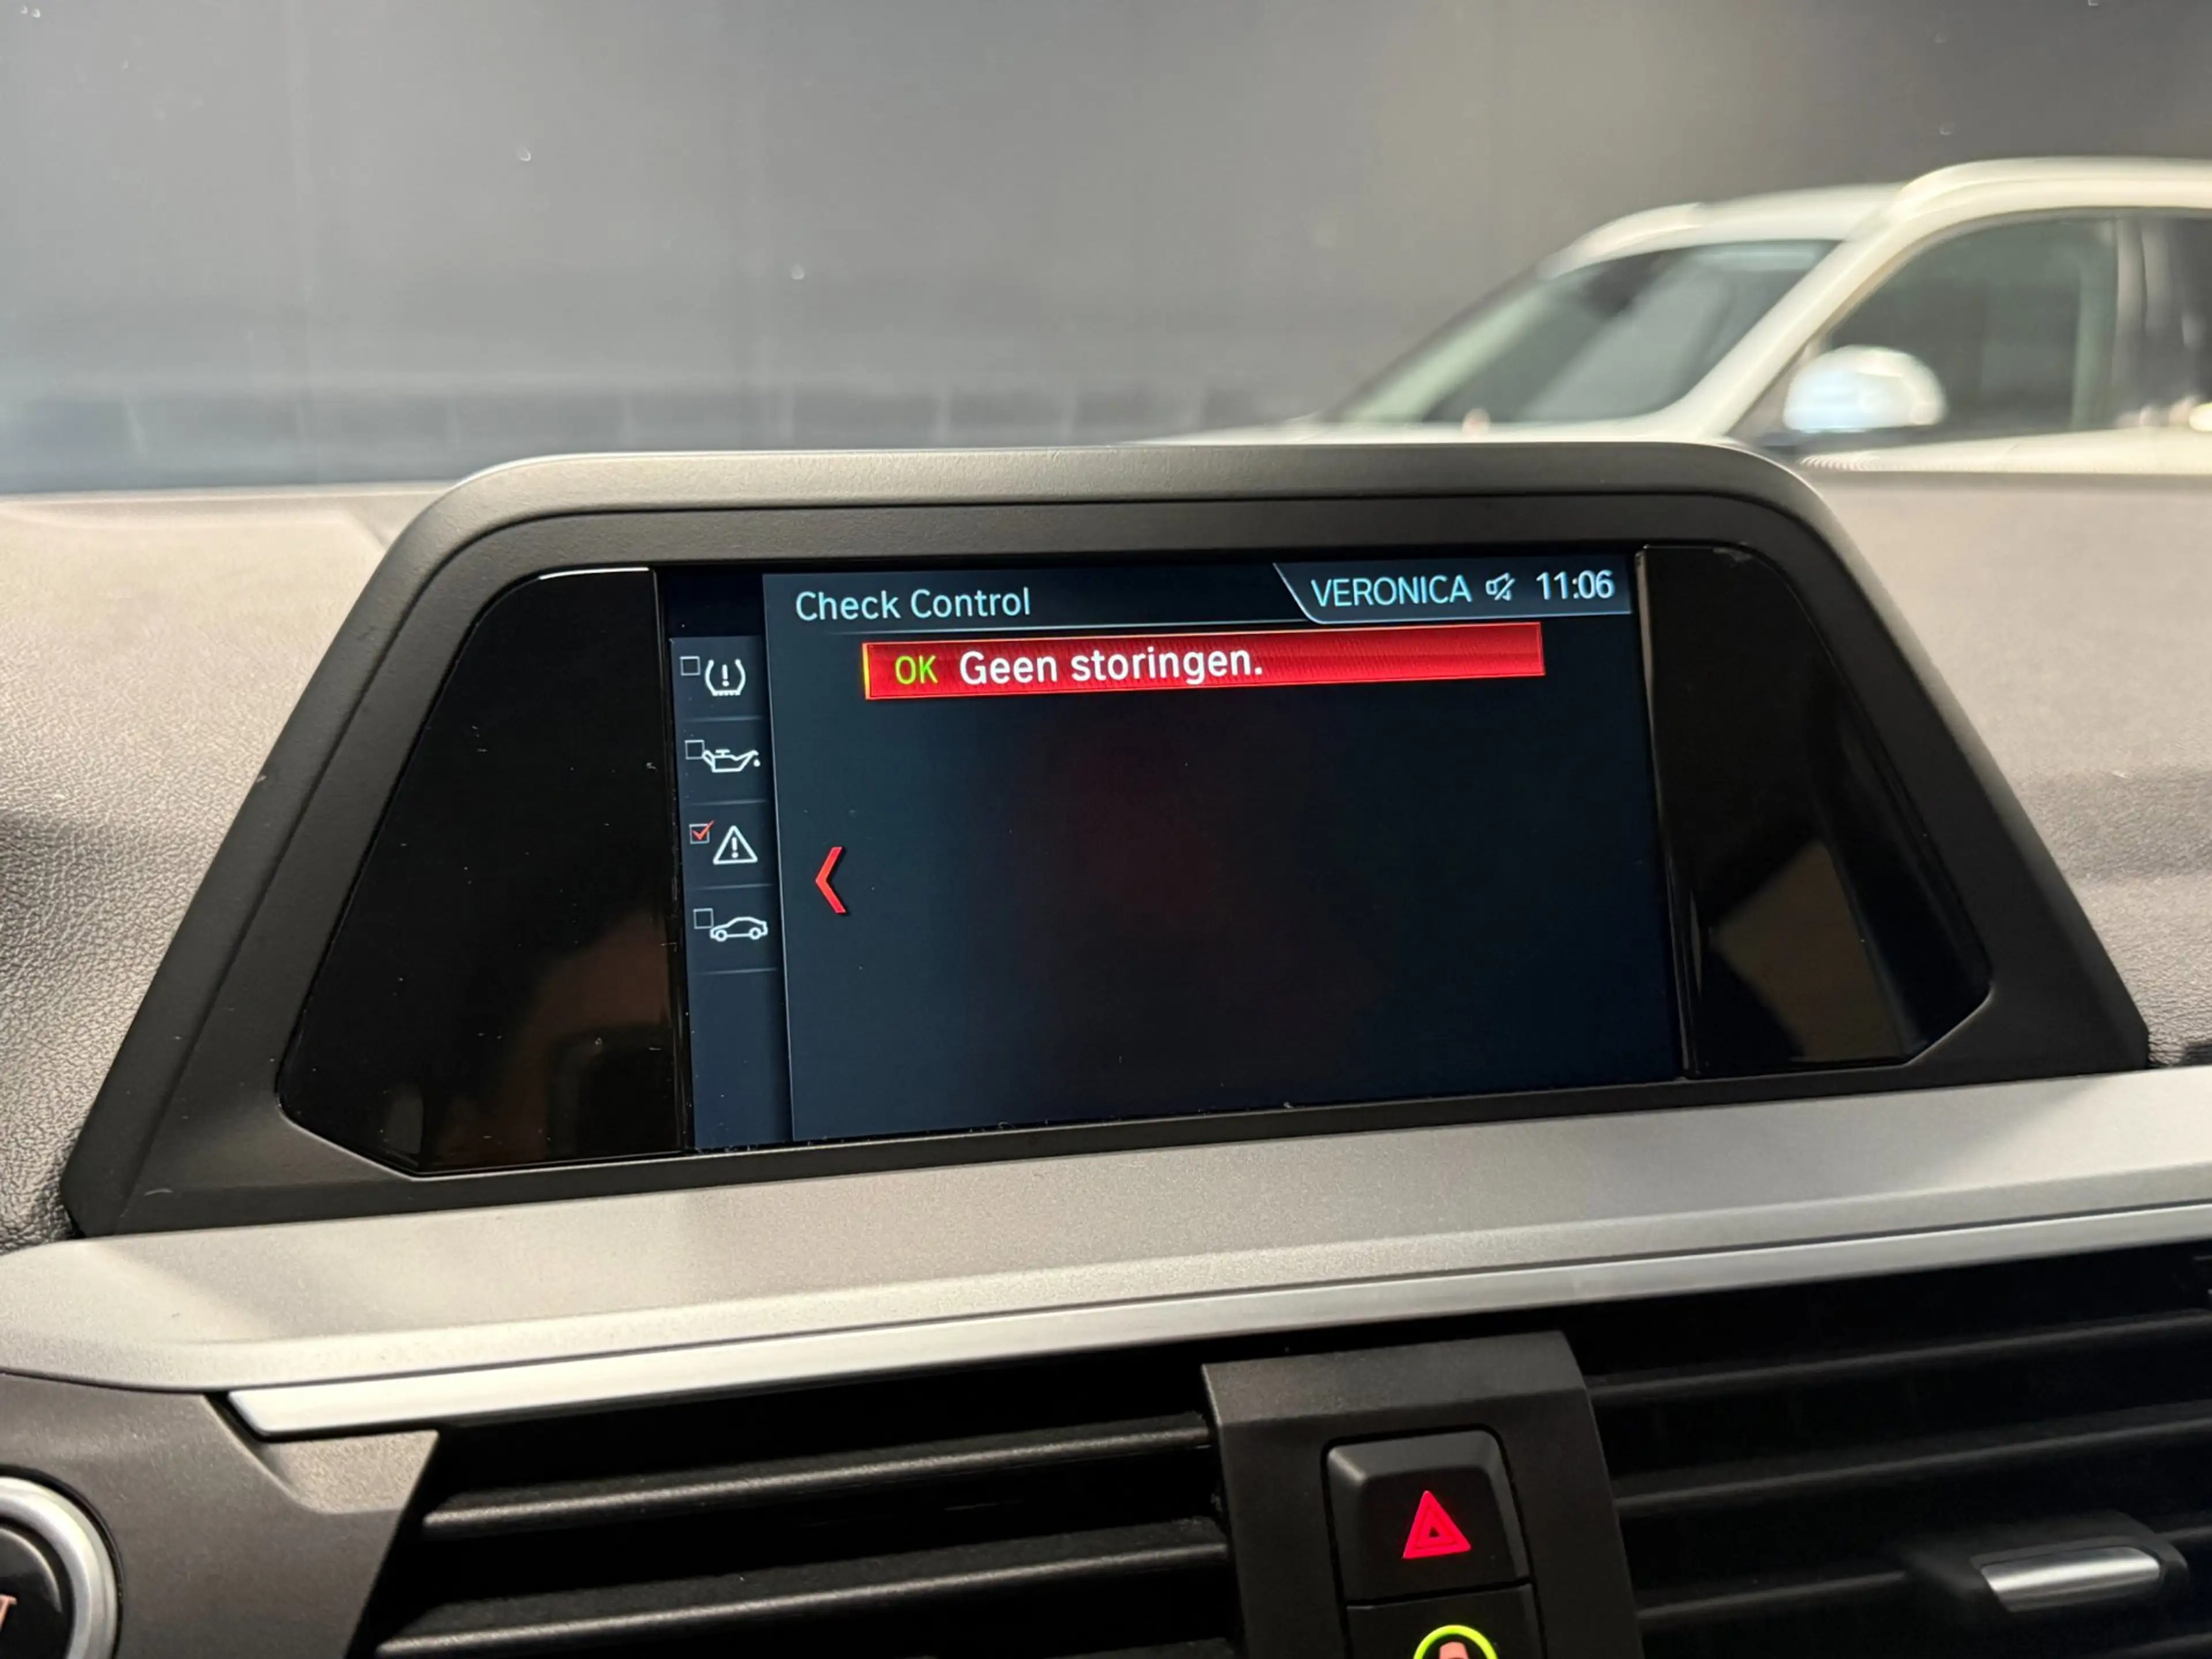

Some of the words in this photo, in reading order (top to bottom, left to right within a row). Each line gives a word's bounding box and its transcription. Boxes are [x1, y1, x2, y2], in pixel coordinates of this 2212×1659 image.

[796, 590, 900, 620] Check
[911, 587, 1031, 618] Control
[1310, 575, 1472, 607] VERONICA
[1536, 570, 1613, 600] 11:06
[895, 655, 938, 685] OK
[960, 651, 1057, 685] Geen
[1070, 646, 1263, 685] storingen.
